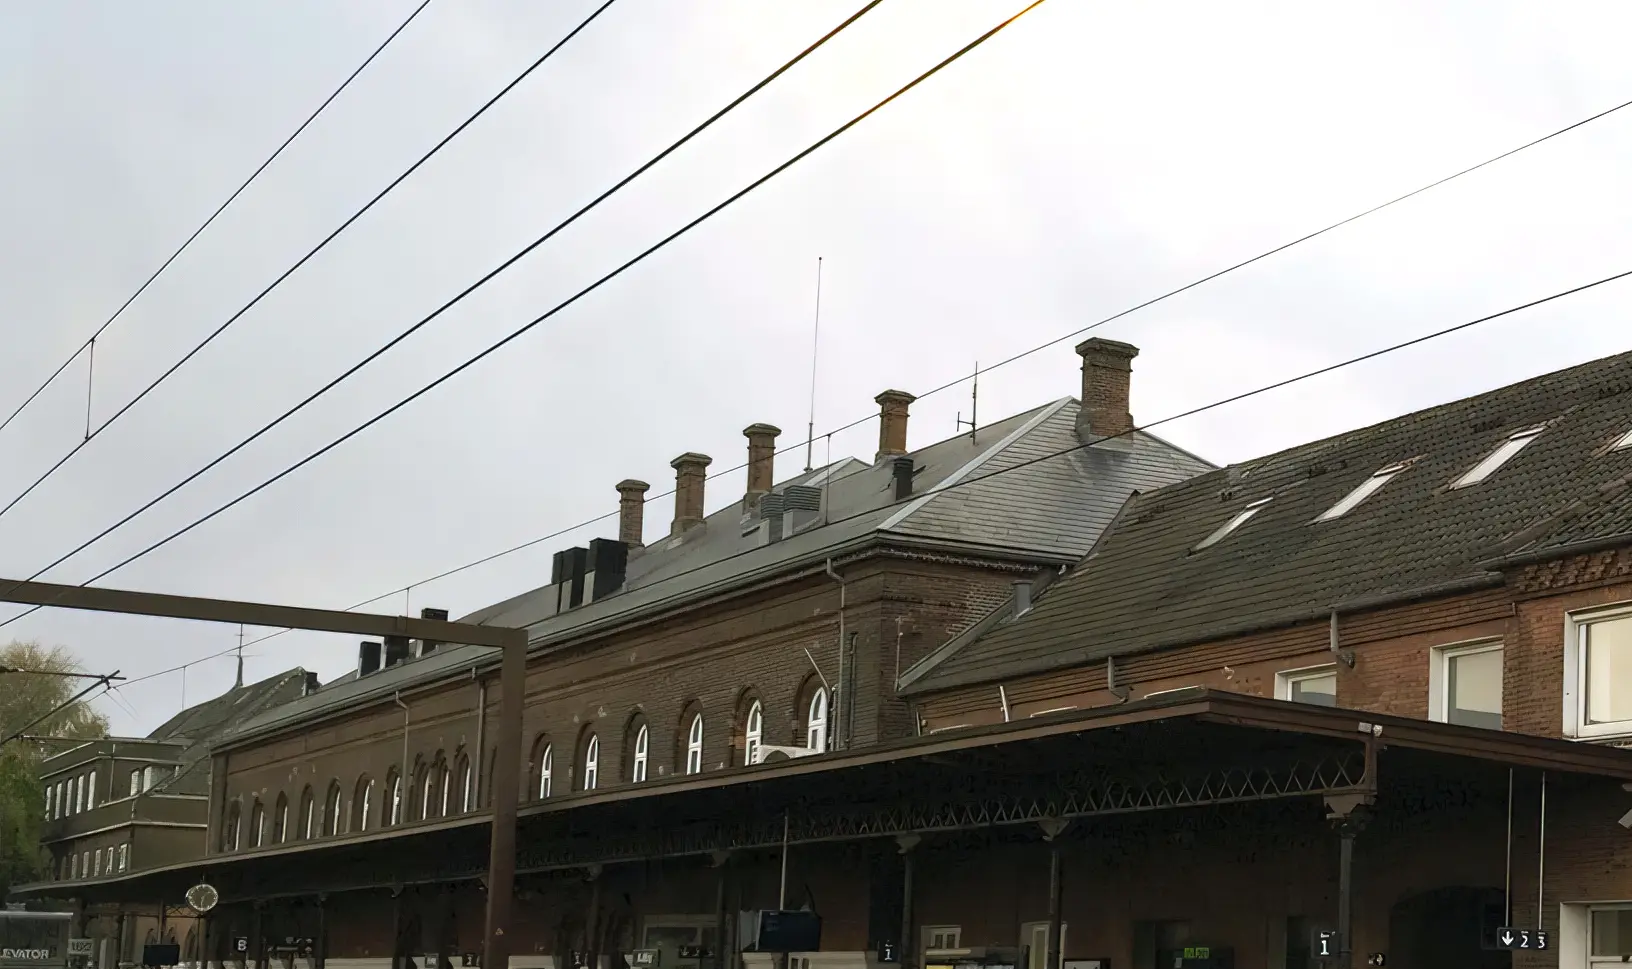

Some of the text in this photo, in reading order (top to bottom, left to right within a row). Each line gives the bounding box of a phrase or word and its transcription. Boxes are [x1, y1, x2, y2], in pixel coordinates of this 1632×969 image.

[237, 940, 247, 951] B
[1320, 940, 1329, 955] 1
[1520, 935, 1546, 949] 2 3
[884, 948, 893, 961] 1
